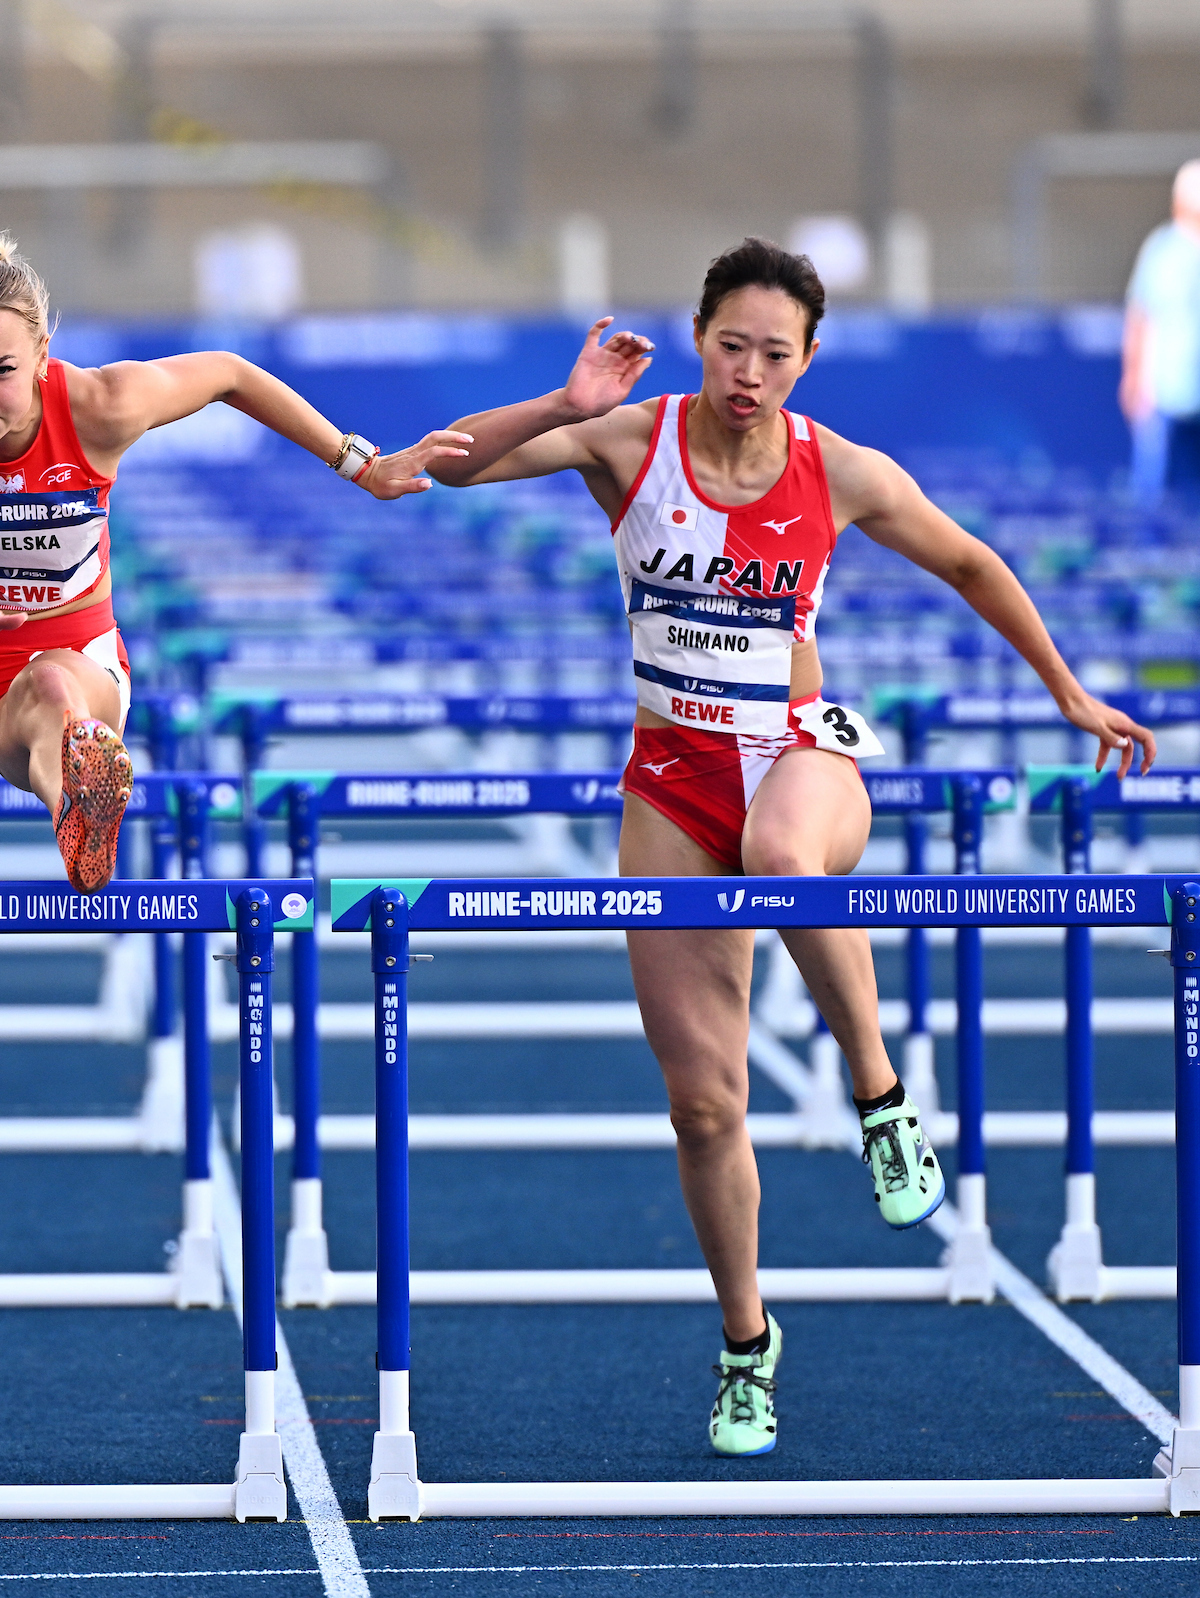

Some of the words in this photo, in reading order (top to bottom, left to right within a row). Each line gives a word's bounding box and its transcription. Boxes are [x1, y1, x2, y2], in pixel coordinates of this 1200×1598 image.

[47, 469, 72, 486] PGE
[51, 500, 91, 519] 2025
[639, 548, 804, 593] JAPAN
[741, 604, 782, 623] 2025
[667, 625, 749, 653] SHIMANO
[700, 684, 724, 693] FISU
[671, 697, 735, 725] REWE
[822, 706, 860, 746] 3
[26, 895, 130, 920] UNIVERSITY
[137, 895, 198, 920] GAMES
[449, 891, 597, 917] RHINE-RUHR
[601, 890, 662, 916] 2025
[751, 896, 795, 908] FISU
[848, 889, 888, 914] FISU
[895, 889, 958, 914] WORLD
[964, 889, 1069, 914] UNIVERSITY
[1075, 889, 1136, 914] GAMES
[248, 995, 264, 1064] MONDO
[383, 996, 398, 1065] MONDO
[1183, 989, 1199, 1058] MONDO
